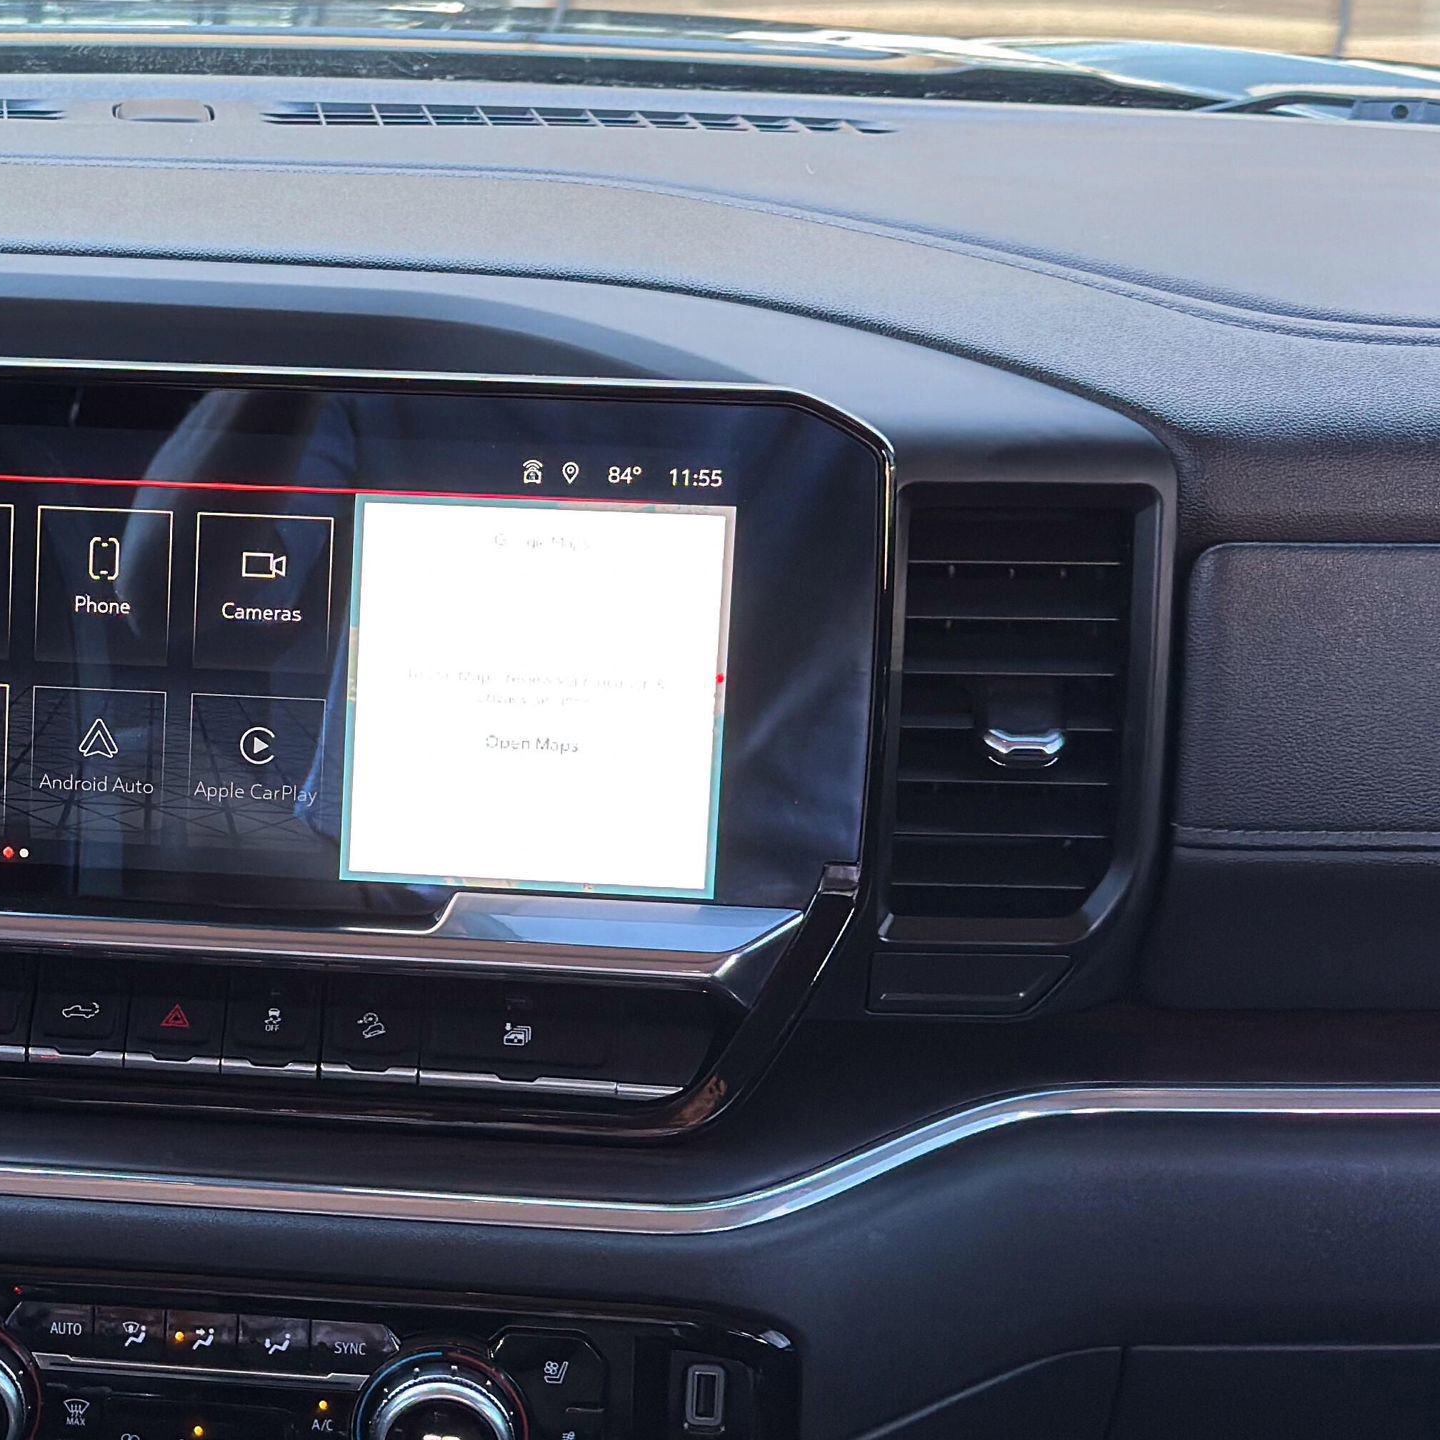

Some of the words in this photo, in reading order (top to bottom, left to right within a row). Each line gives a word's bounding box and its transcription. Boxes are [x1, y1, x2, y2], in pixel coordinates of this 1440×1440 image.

[669, 468, 723, 488] 11:55
[74, 593, 131, 615] Phone
[221, 602, 302, 622] Cameras
[39, 773, 108, 793] Android
[111, 776, 154, 796] Auto
[194, 779, 245, 803] Apple
[250, 782, 318, 807] CarPlay
[49, 1321, 82, 1336] AUTO
[333, 1341, 367, 1356] SYNC
[65, 1416, 86, 1427] MAX
[311, 1419, 335, 1432] A/C
